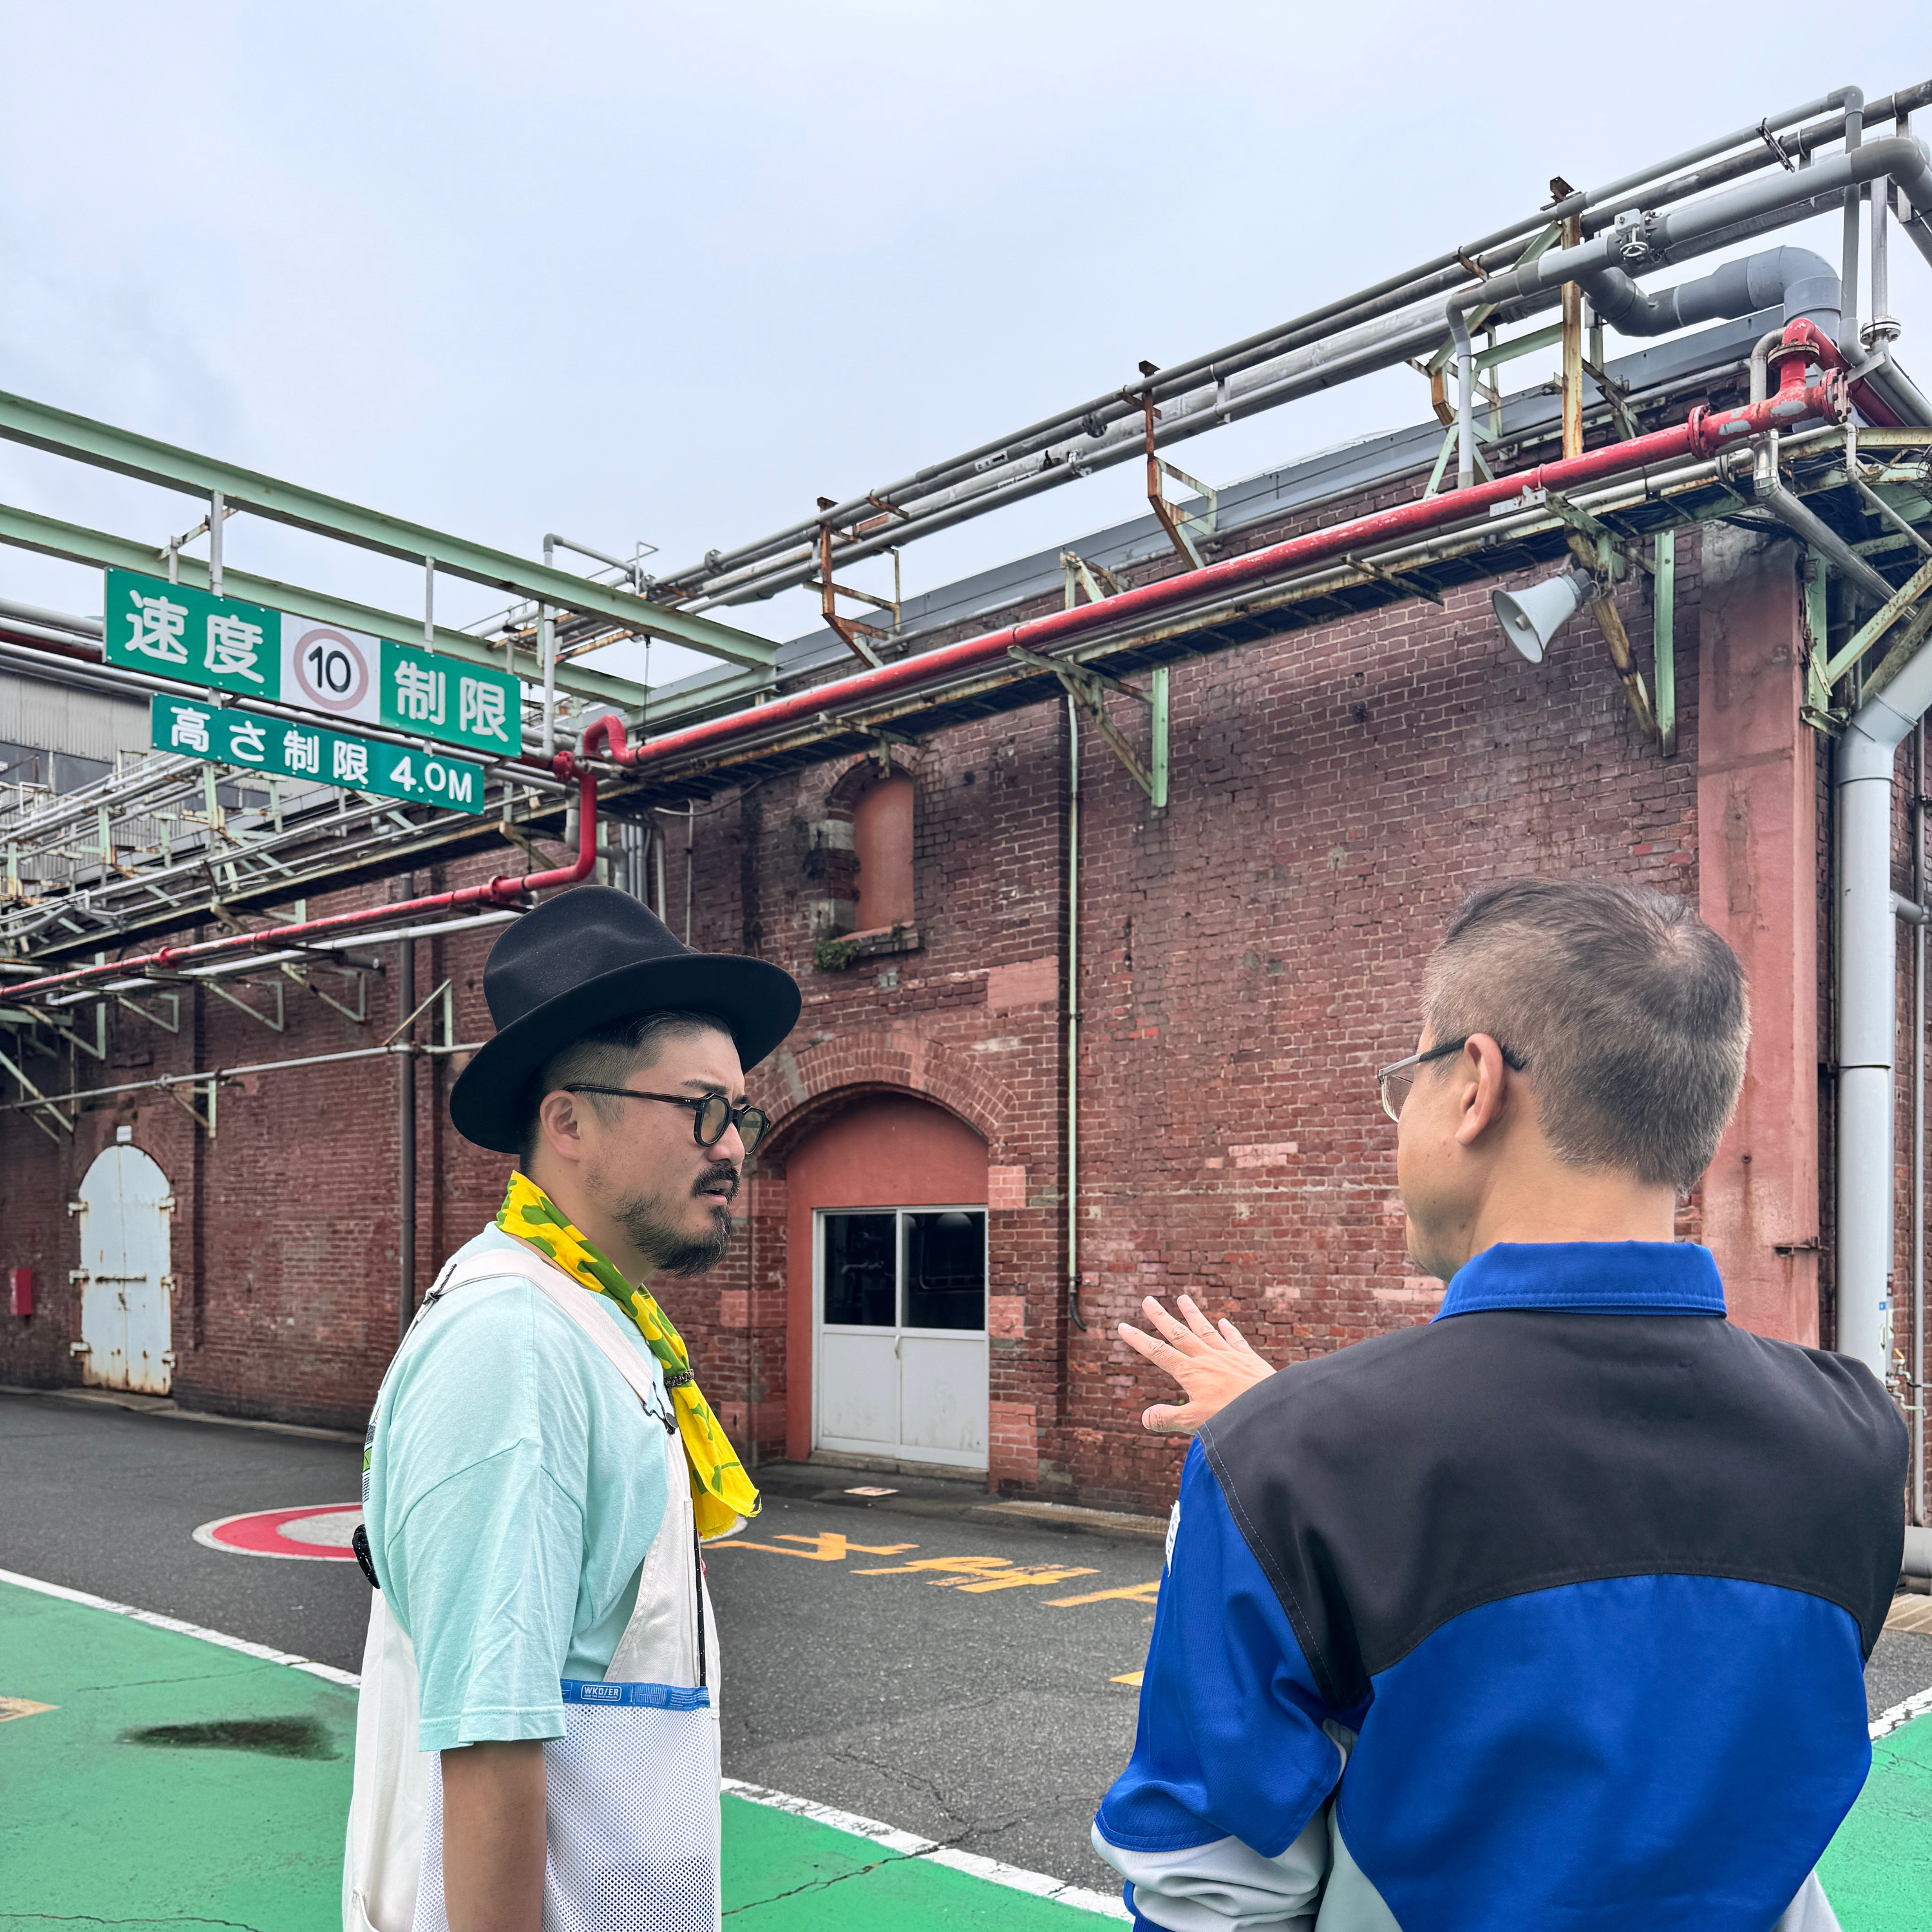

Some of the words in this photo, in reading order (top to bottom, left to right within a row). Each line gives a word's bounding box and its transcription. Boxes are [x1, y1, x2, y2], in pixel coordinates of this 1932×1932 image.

[125, 590, 265, 683] 速度
[308, 646, 351, 693] 10
[395, 660, 509, 742] 制限
[171, 707, 368, 785] 高さ制限
[390, 755, 472, 803] 4.0M
